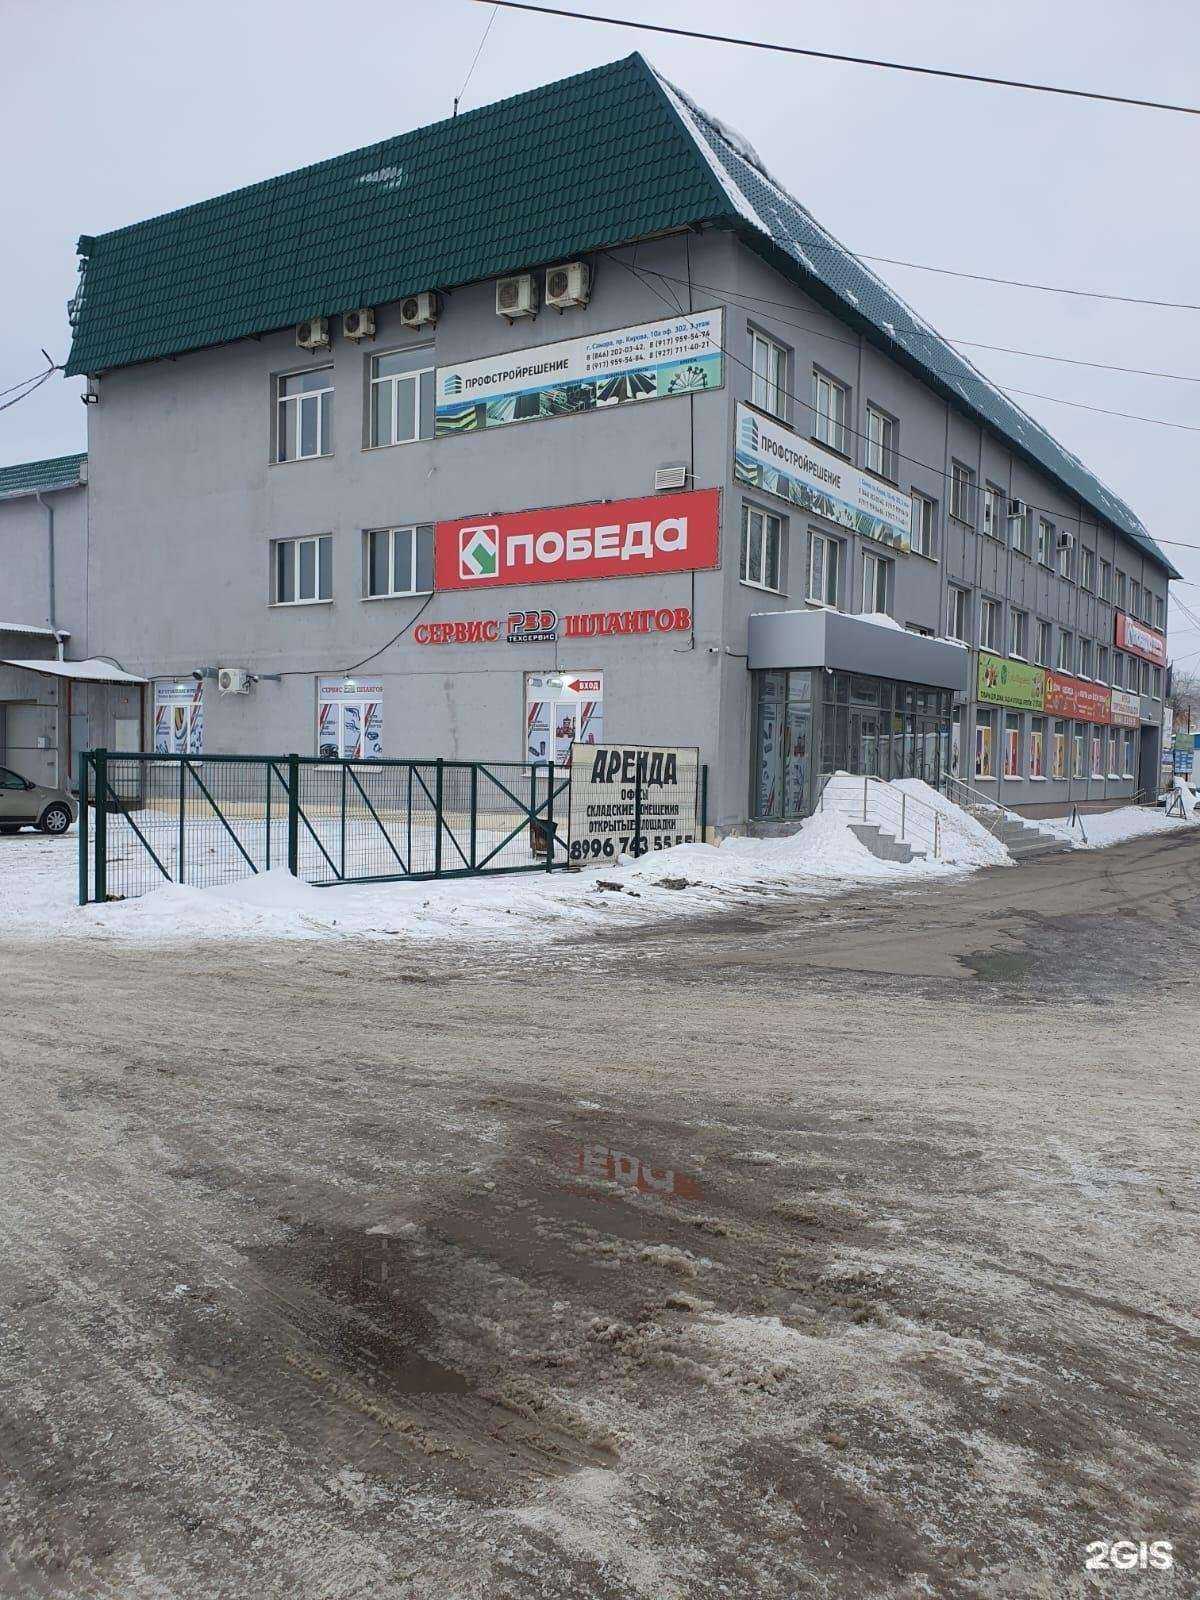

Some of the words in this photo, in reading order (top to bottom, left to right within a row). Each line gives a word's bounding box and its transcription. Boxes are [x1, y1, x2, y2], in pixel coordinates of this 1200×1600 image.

[465, 358, 569, 389] ПРОФСТРОЙРЕШЕНИЕ
[761, 436, 841, 490] ПРОФСТРОЙРЕШЕНИЕ
[413, 619, 499, 644] СЕРВИС
[564, 607, 691, 638] ШЛАНГОВ
[508, 634, 555, 642] ТЕХСЕРВИС
[580, 681, 599, 690] ВХОД
[591, 750, 678, 788] АРЕНДА
[586, 804, 634, 817] СКЛАДСКИЕ
[639, 804, 680, 815] ОМЕЩЕНИЯ
[588, 820, 636, 833] ОТКРЫТЫЕ
[639, 819, 677, 831] ЛОЩАДКИ
[570, 838, 614, 860] 8996
